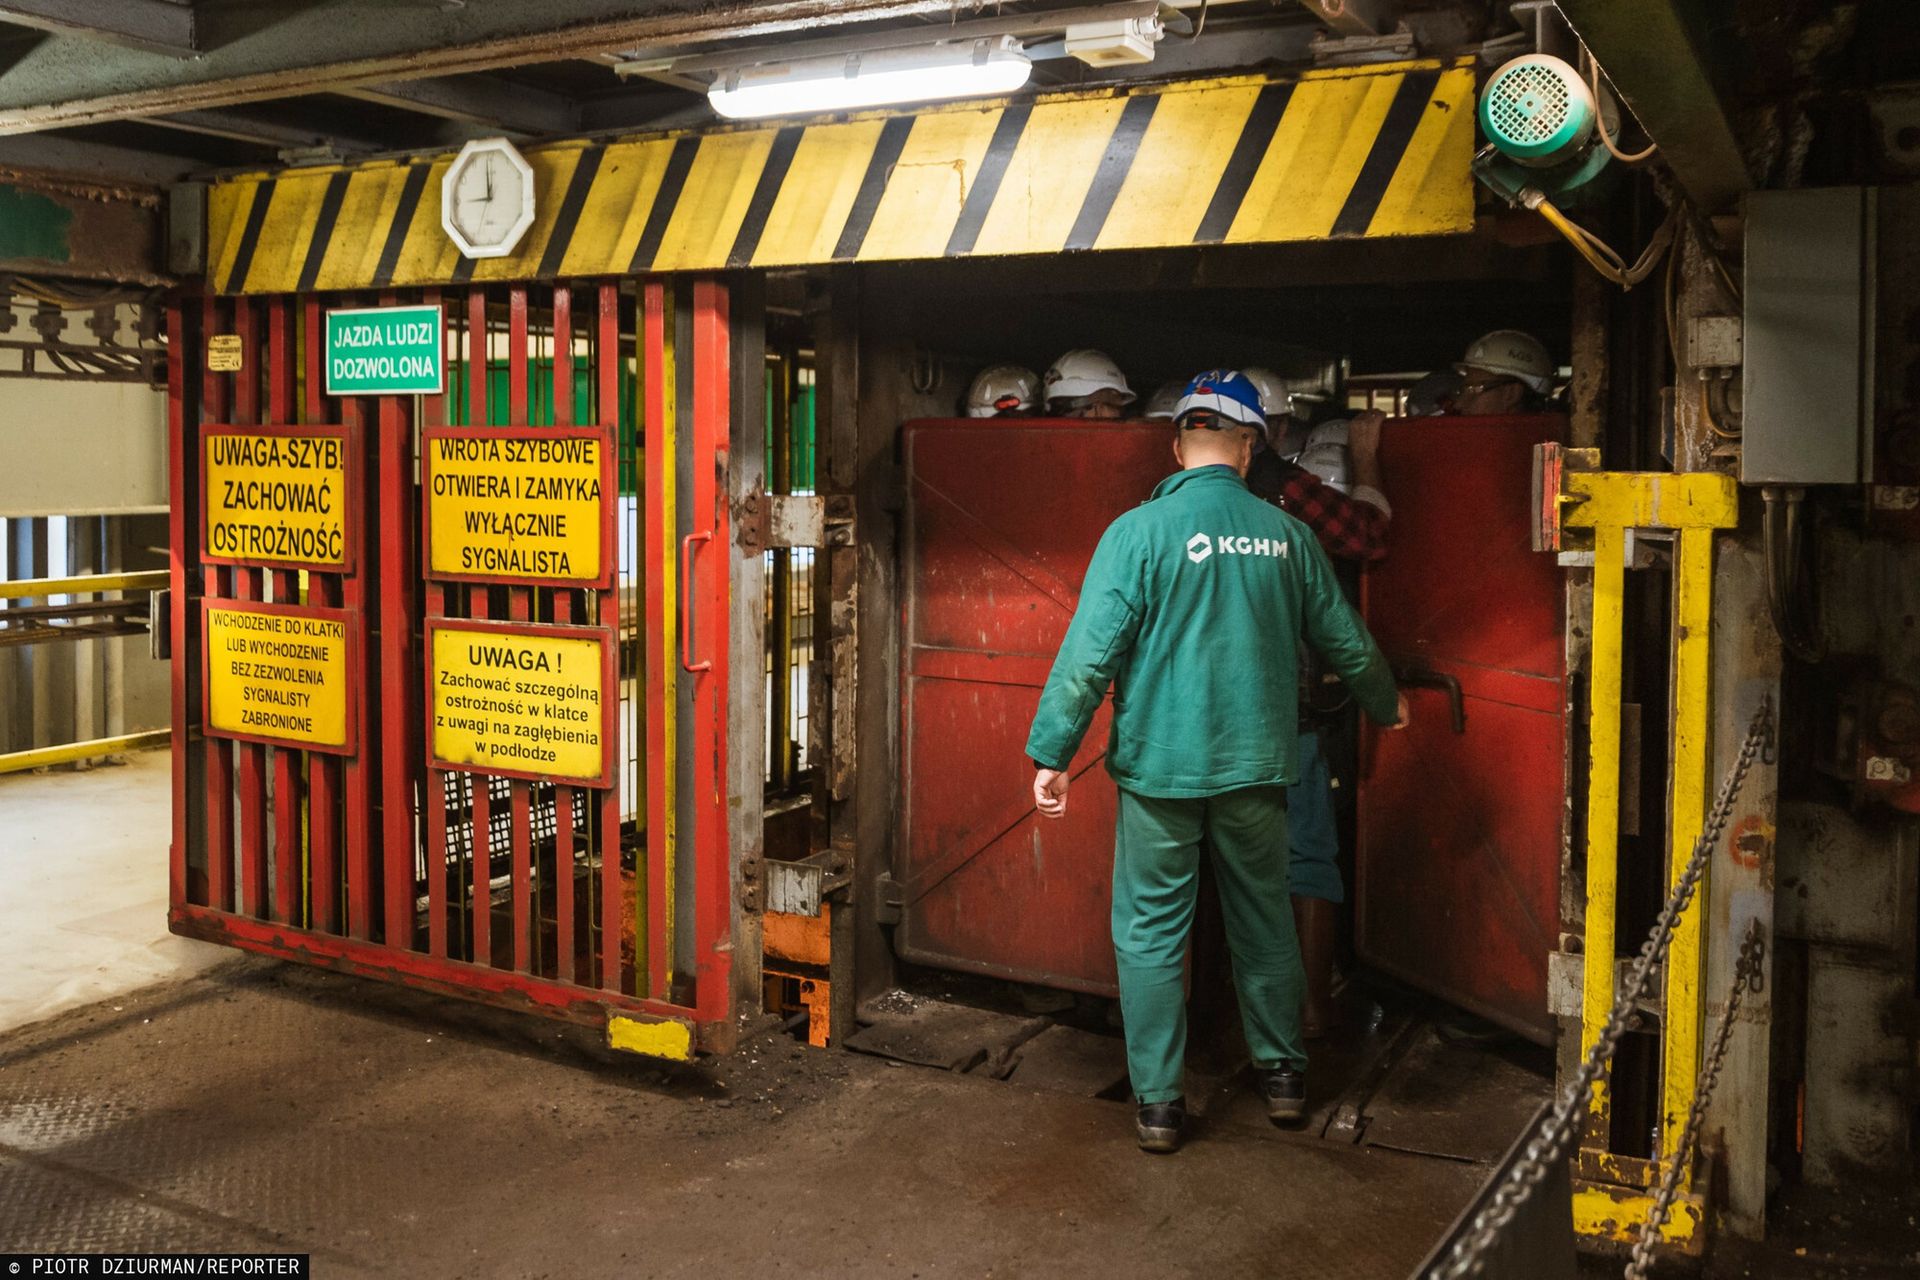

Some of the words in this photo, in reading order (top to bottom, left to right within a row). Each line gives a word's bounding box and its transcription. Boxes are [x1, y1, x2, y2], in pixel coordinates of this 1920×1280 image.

[334, 325, 383, 348] JAZDA
[386, 323, 433, 346] LUDZI
[334, 356, 435, 379] DOZWOLONA
[213, 437, 344, 470] UWAGA-SZYB!
[439, 439, 500, 461] WROTA
[505, 439, 594, 464] SZYBOWE
[223, 477, 331, 514] ZACHOWAĆ
[434, 474, 511, 498] OTWIERA
[516, 476, 520, 498] I
[525, 477, 600, 501] ZAMYKA
[213, 520, 342, 559] OSTROŻNOŚĆ
[465, 511, 567, 541] WYŁĄCZNIE
[462, 546, 571, 574] SYGNALISTA
[1218, 535, 1288, 558] KGHM
[213, 612, 282, 633] WCHODZENIE
[285, 620, 301, 634] DO
[304, 621, 344, 639] KLATKI
[226, 637, 246, 653] LUB
[249, 640, 329, 661] WYCHODZENIE
[469, 645, 550, 672] UWAGA
[557, 653, 562, 673] !
[231, 661, 251, 677] BEZ
[254, 664, 325, 685] ZEZWOLENIA
[243, 686, 310, 708] SYGNALISTY
[440, 670, 511, 692] Zachować
[515, 681, 599, 705] szczególną
[241, 709, 312, 732] ZABRONIONE
[445, 695, 523, 715] ostrożność
[528, 706, 539, 716] w
[545, 703, 588, 722] klatce
[437, 715, 444, 727] z
[449, 717, 489, 735] uwagi
[493, 722, 510, 735] na
[514, 724, 598, 745] zagłębienia
[475, 741, 486, 752] w
[491, 743, 556, 762] podłodze
